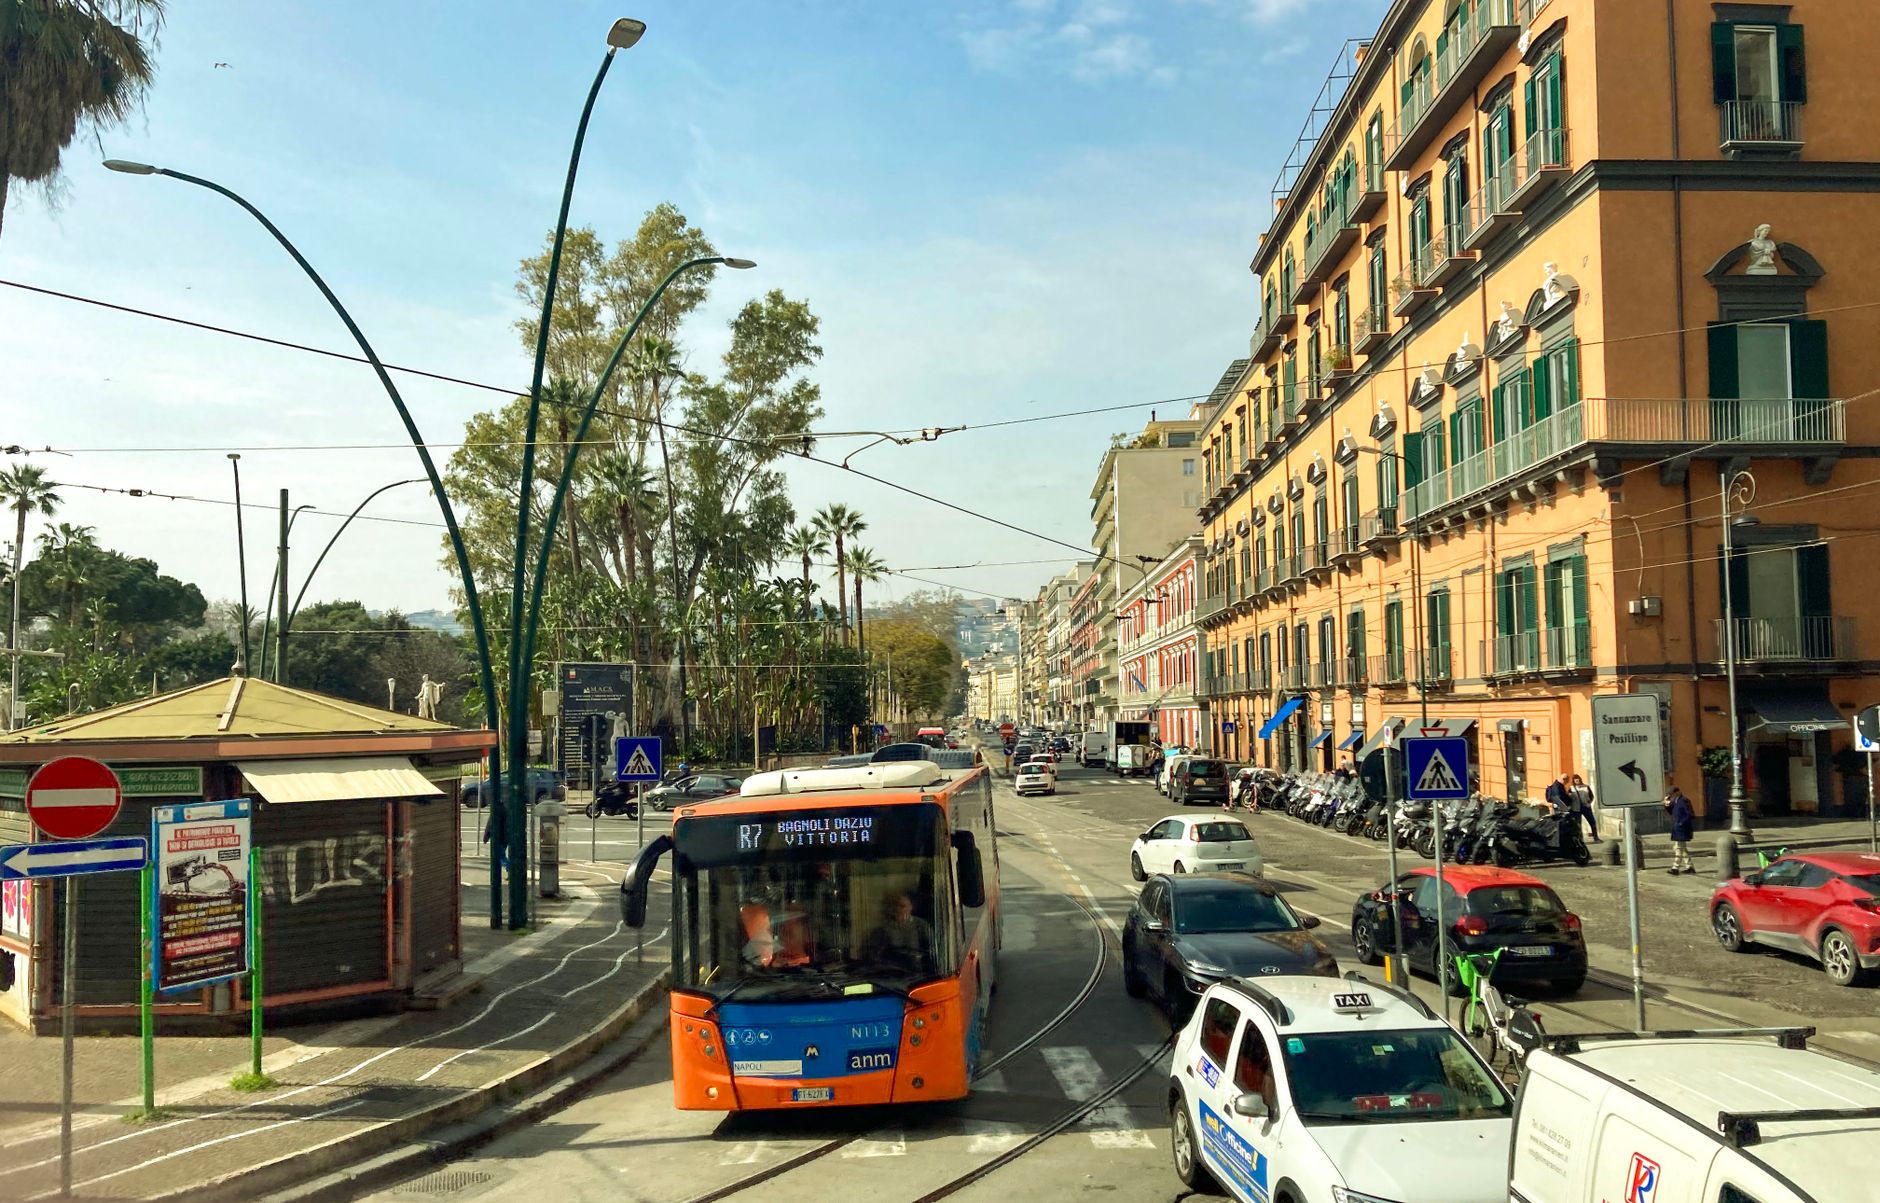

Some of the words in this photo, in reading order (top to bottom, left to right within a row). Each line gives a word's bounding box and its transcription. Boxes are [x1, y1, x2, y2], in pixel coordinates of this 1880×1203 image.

[1609, 733, 1648, 744] Posillipo
[777, 819, 830, 833] BAGNOLI
[740, 824, 762, 848] R7
[785, 830, 870, 846] VITTORIA
[1335, 994, 1370, 1006] TAXI
[851, 1024, 890, 1039] N113
[734, 1062, 762, 1071] NAPOLI
[851, 1053, 891, 1069] anm
